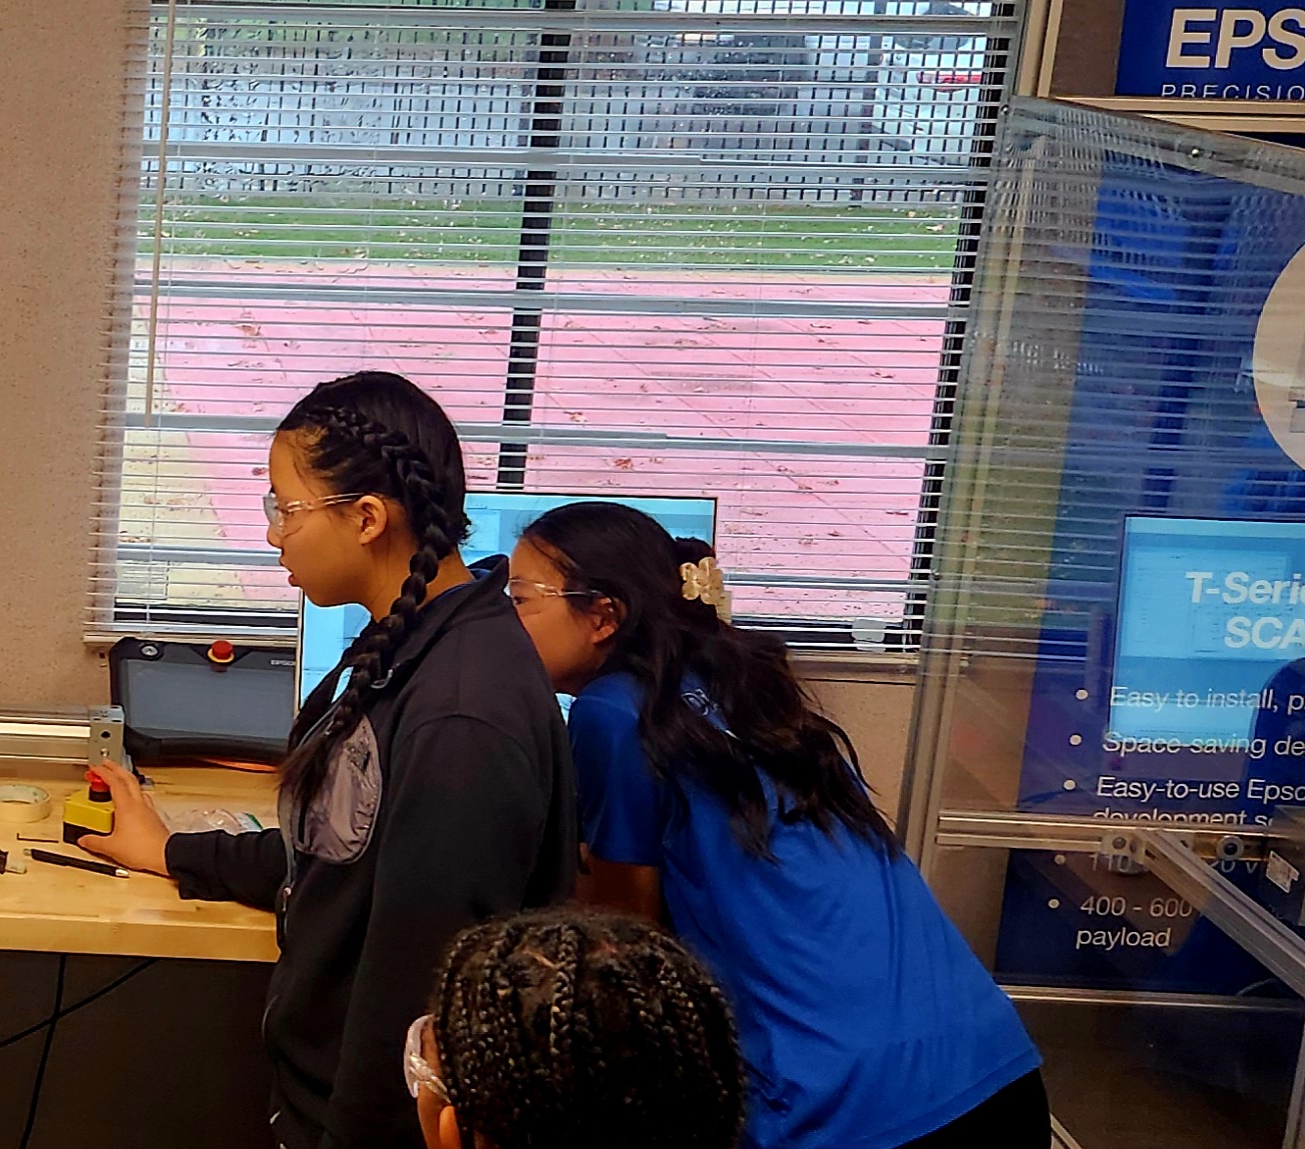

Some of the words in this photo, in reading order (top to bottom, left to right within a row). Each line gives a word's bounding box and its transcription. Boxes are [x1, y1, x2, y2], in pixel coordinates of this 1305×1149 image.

[1165, 8, 1305, 70] EPS
[1161, 84, 1305, 99] PRECISIO
[1186, 571, 1305, 605] T-Seri
[1224, 616, 1305, 650] SCA
[1110, 686, 1169, 712] Easy
[1175, 689, 1200, 708] to
[1206, 688, 1279, 713] install,
[1287, 695, 1305, 716] p
[1102, 732, 1267, 759] Space-saving
[1096, 776, 1240, 803] Easy-to-use
[1254, 815, 1274, 827] s
[1080, 896, 1127, 917] 400
[1149, 898, 1193, 918] 600
[1076, 927, 1172, 951] payload
